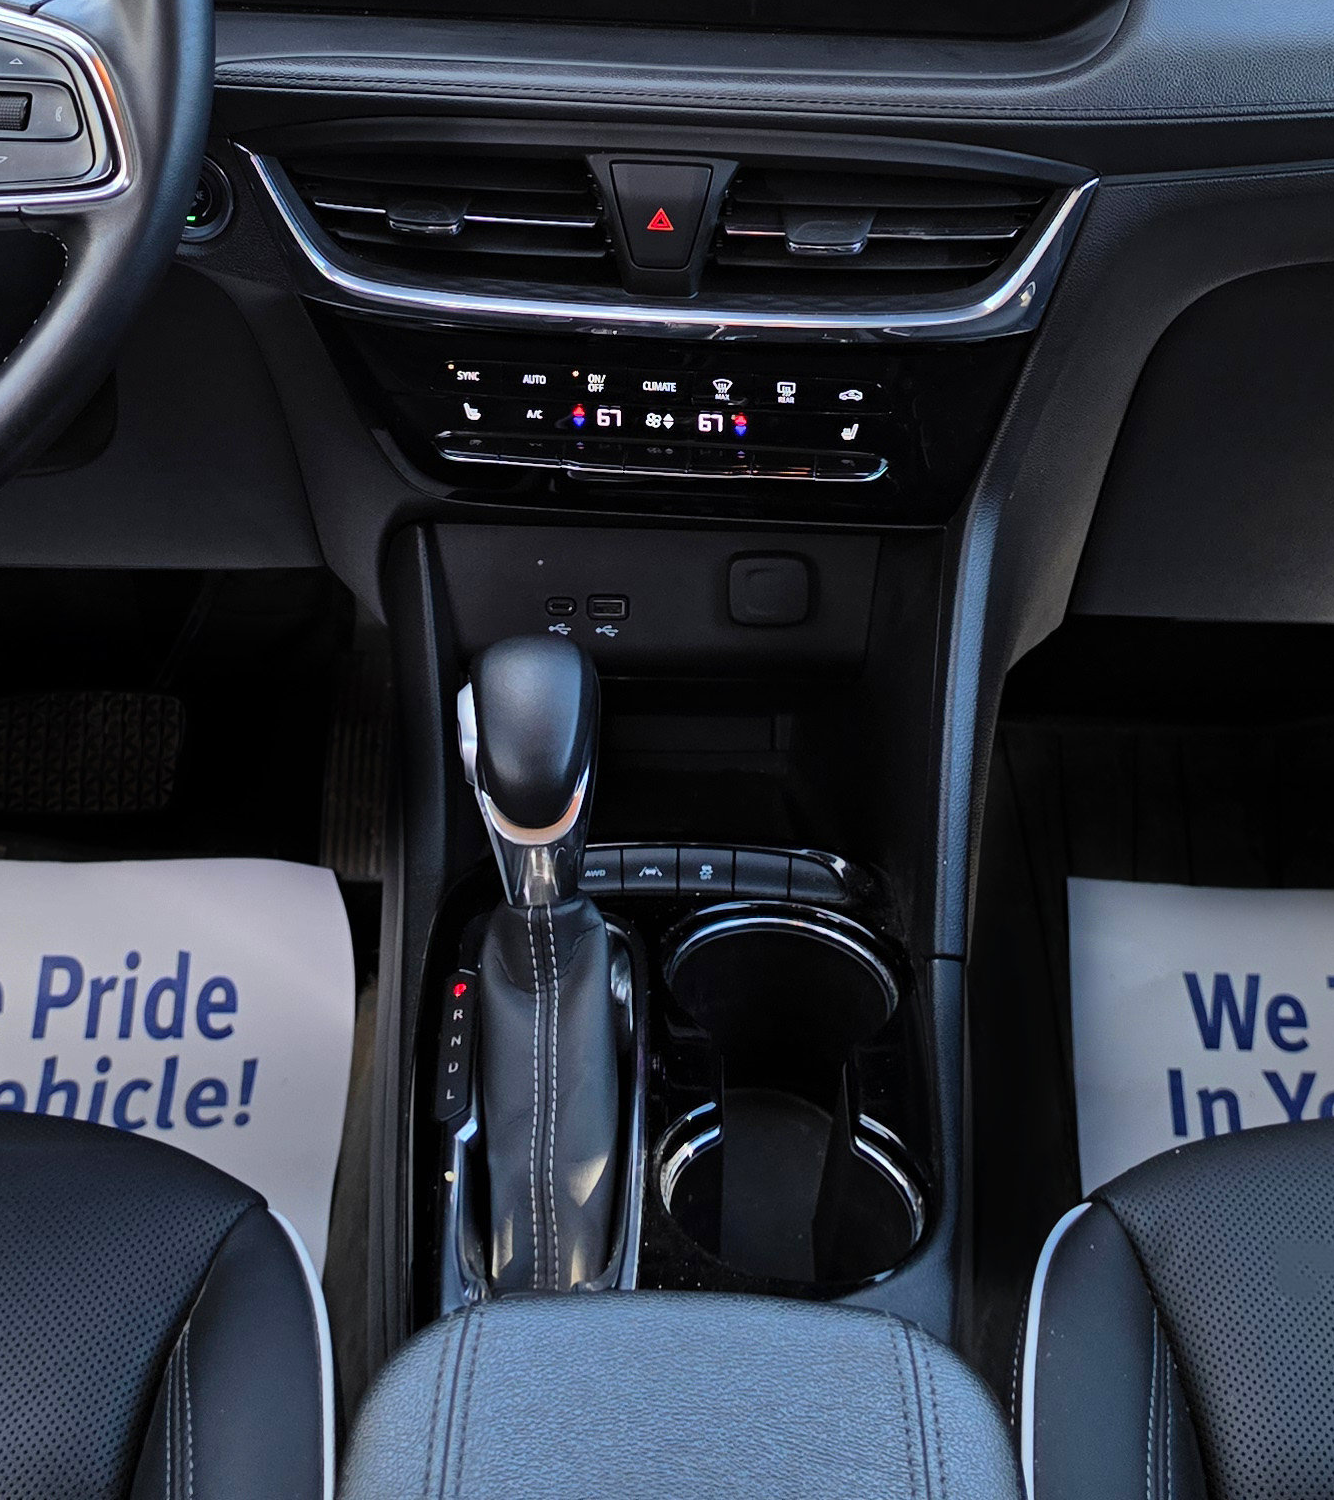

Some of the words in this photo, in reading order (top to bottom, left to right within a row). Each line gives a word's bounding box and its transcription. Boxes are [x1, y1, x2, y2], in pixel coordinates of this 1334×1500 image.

[456, 370, 481, 381] SYNC
[522, 374, 547, 385] AUTO
[587, 373, 607, 384] ON/
[587, 383, 604, 393] OFF
[642, 380, 677, 393] CLIMATE
[526, 409, 544, 420] A/C
[596, 408, 622, 427] 67
[698, 412, 724, 433] 67
[584, 868, 606, 878] AWD
[31, 949, 240, 1041] Pride
[453, 1008, 464, 1020] R
[1182, 971, 1310, 1052] We
[450, 1034, 462, 1047] N
[448, 1062, 459, 1073] D
[446, 1088, 455, 1100] L
[1166, 1067, 1243, 1139] In
